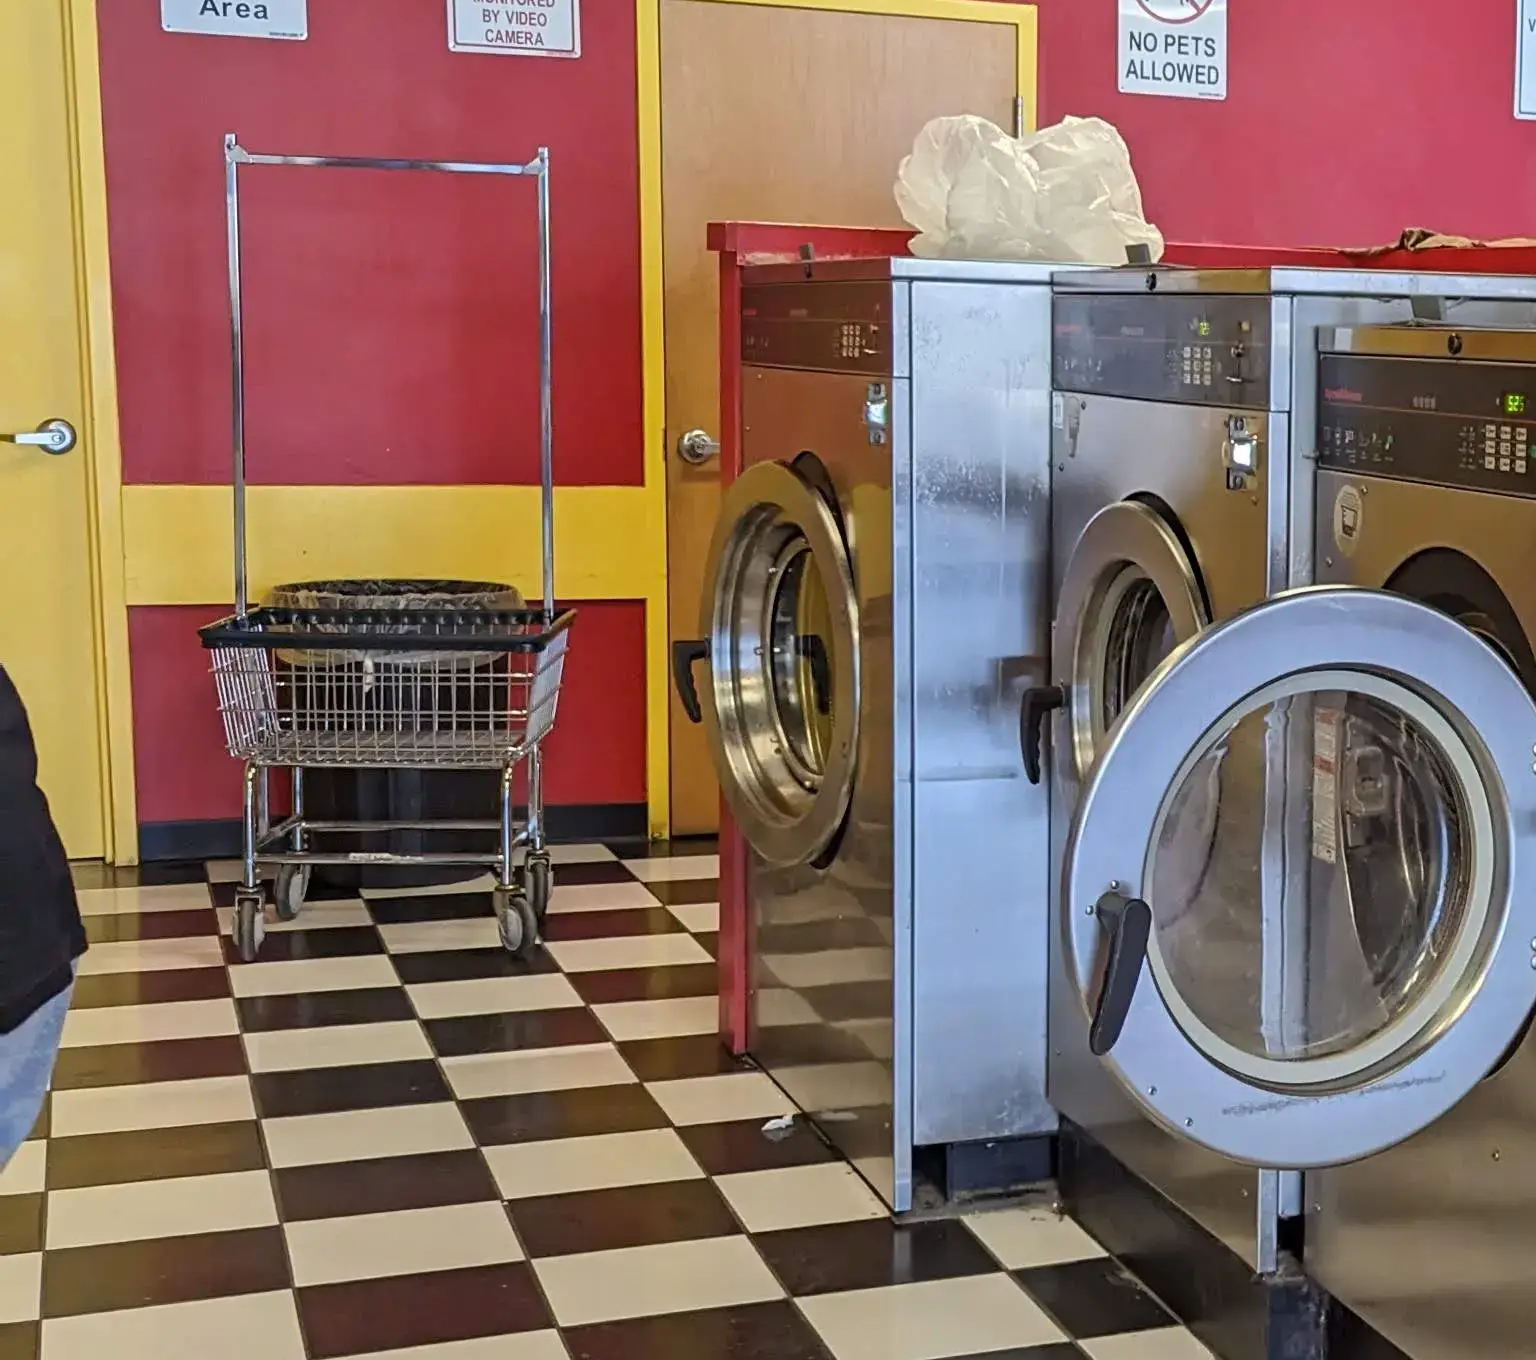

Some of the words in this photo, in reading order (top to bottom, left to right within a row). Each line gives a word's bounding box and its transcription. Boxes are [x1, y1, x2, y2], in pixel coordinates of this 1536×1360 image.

[482, 8, 500, 23] BY
[505, 10, 547, 27] VIDEO
[484, 28, 545, 46] CAMERA
[1129, 31, 1158, 52] NO
[1164, 34, 1216, 57] PETS
[1125, 59, 1219, 85] ALLOWED
